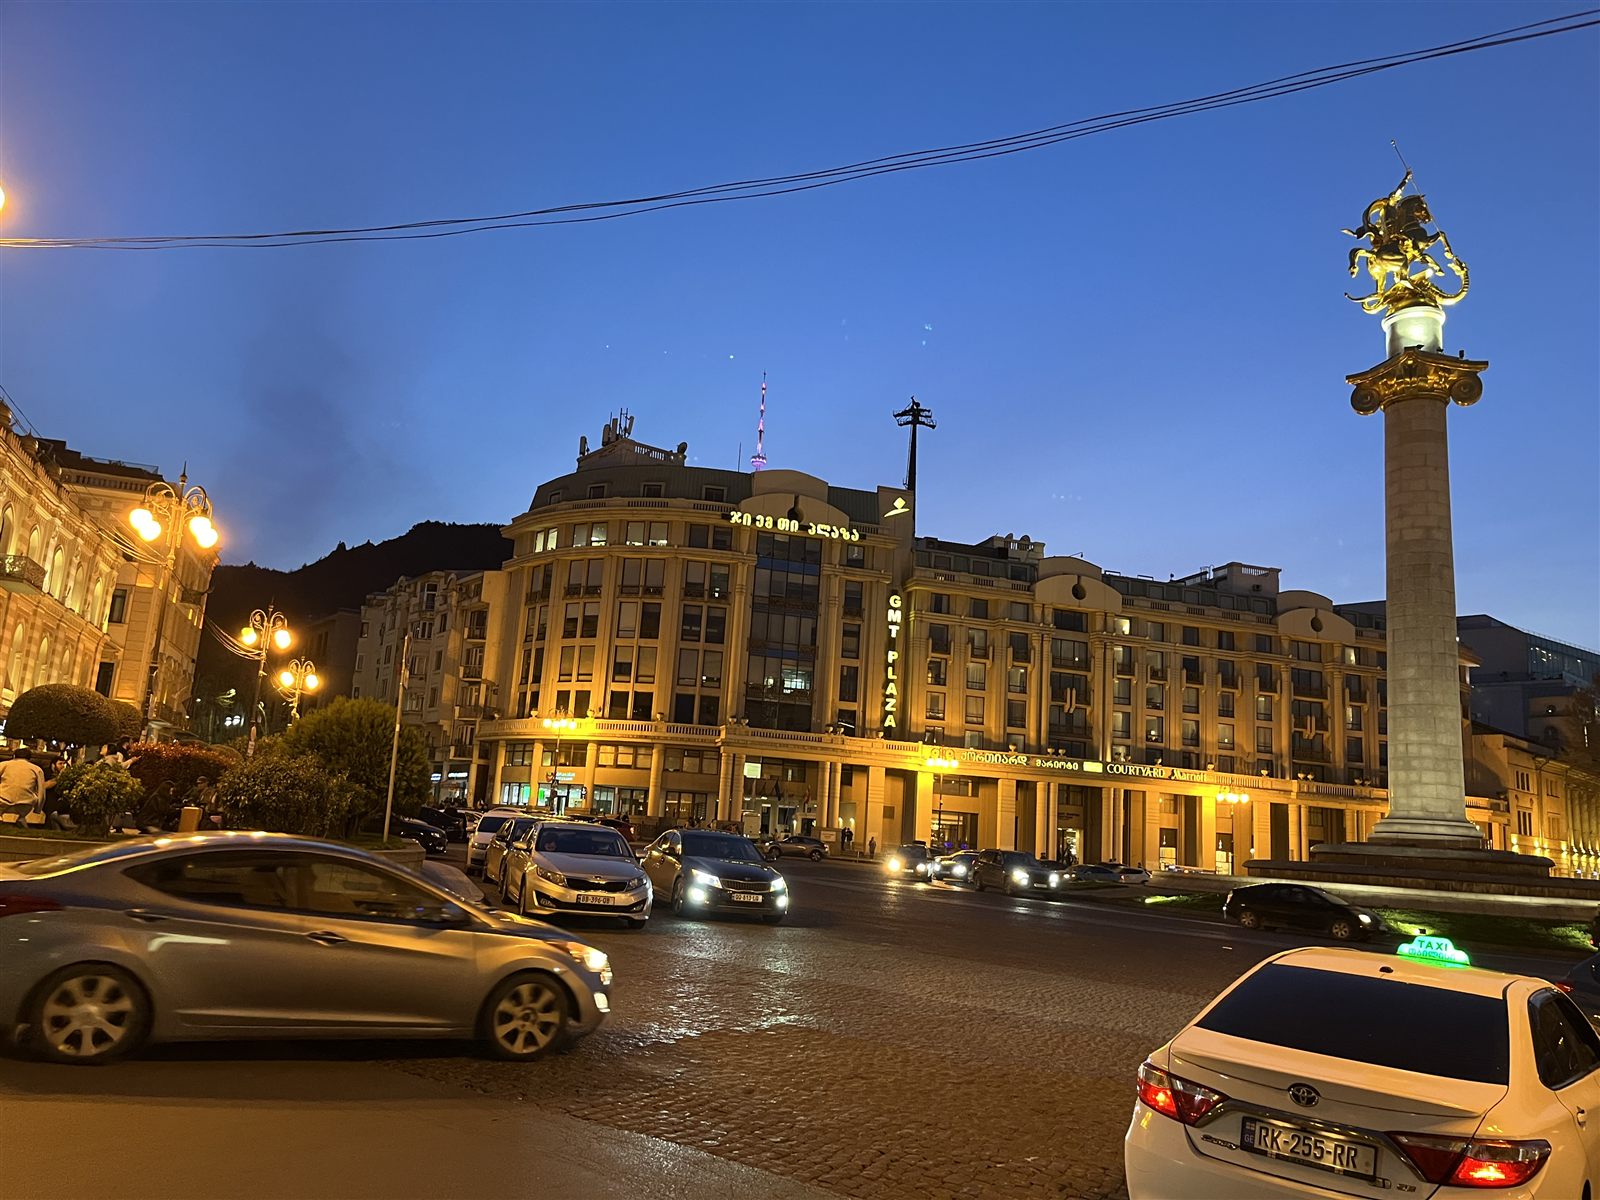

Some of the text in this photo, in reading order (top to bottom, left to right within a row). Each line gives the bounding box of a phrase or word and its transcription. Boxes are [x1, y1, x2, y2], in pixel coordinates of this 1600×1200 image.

[729, 511, 752, 526] ჯი
[777, 517, 799, 533] თი
[807, 522, 860, 542] პლაზა
[884, 594, 902, 727] GMT PLAZA
[1106, 763, 1166, 778] COURTYARD
[1418, 940, 1448, 951] TAXI
[1244, 1126, 1358, 1169] GE RK-255-RR
